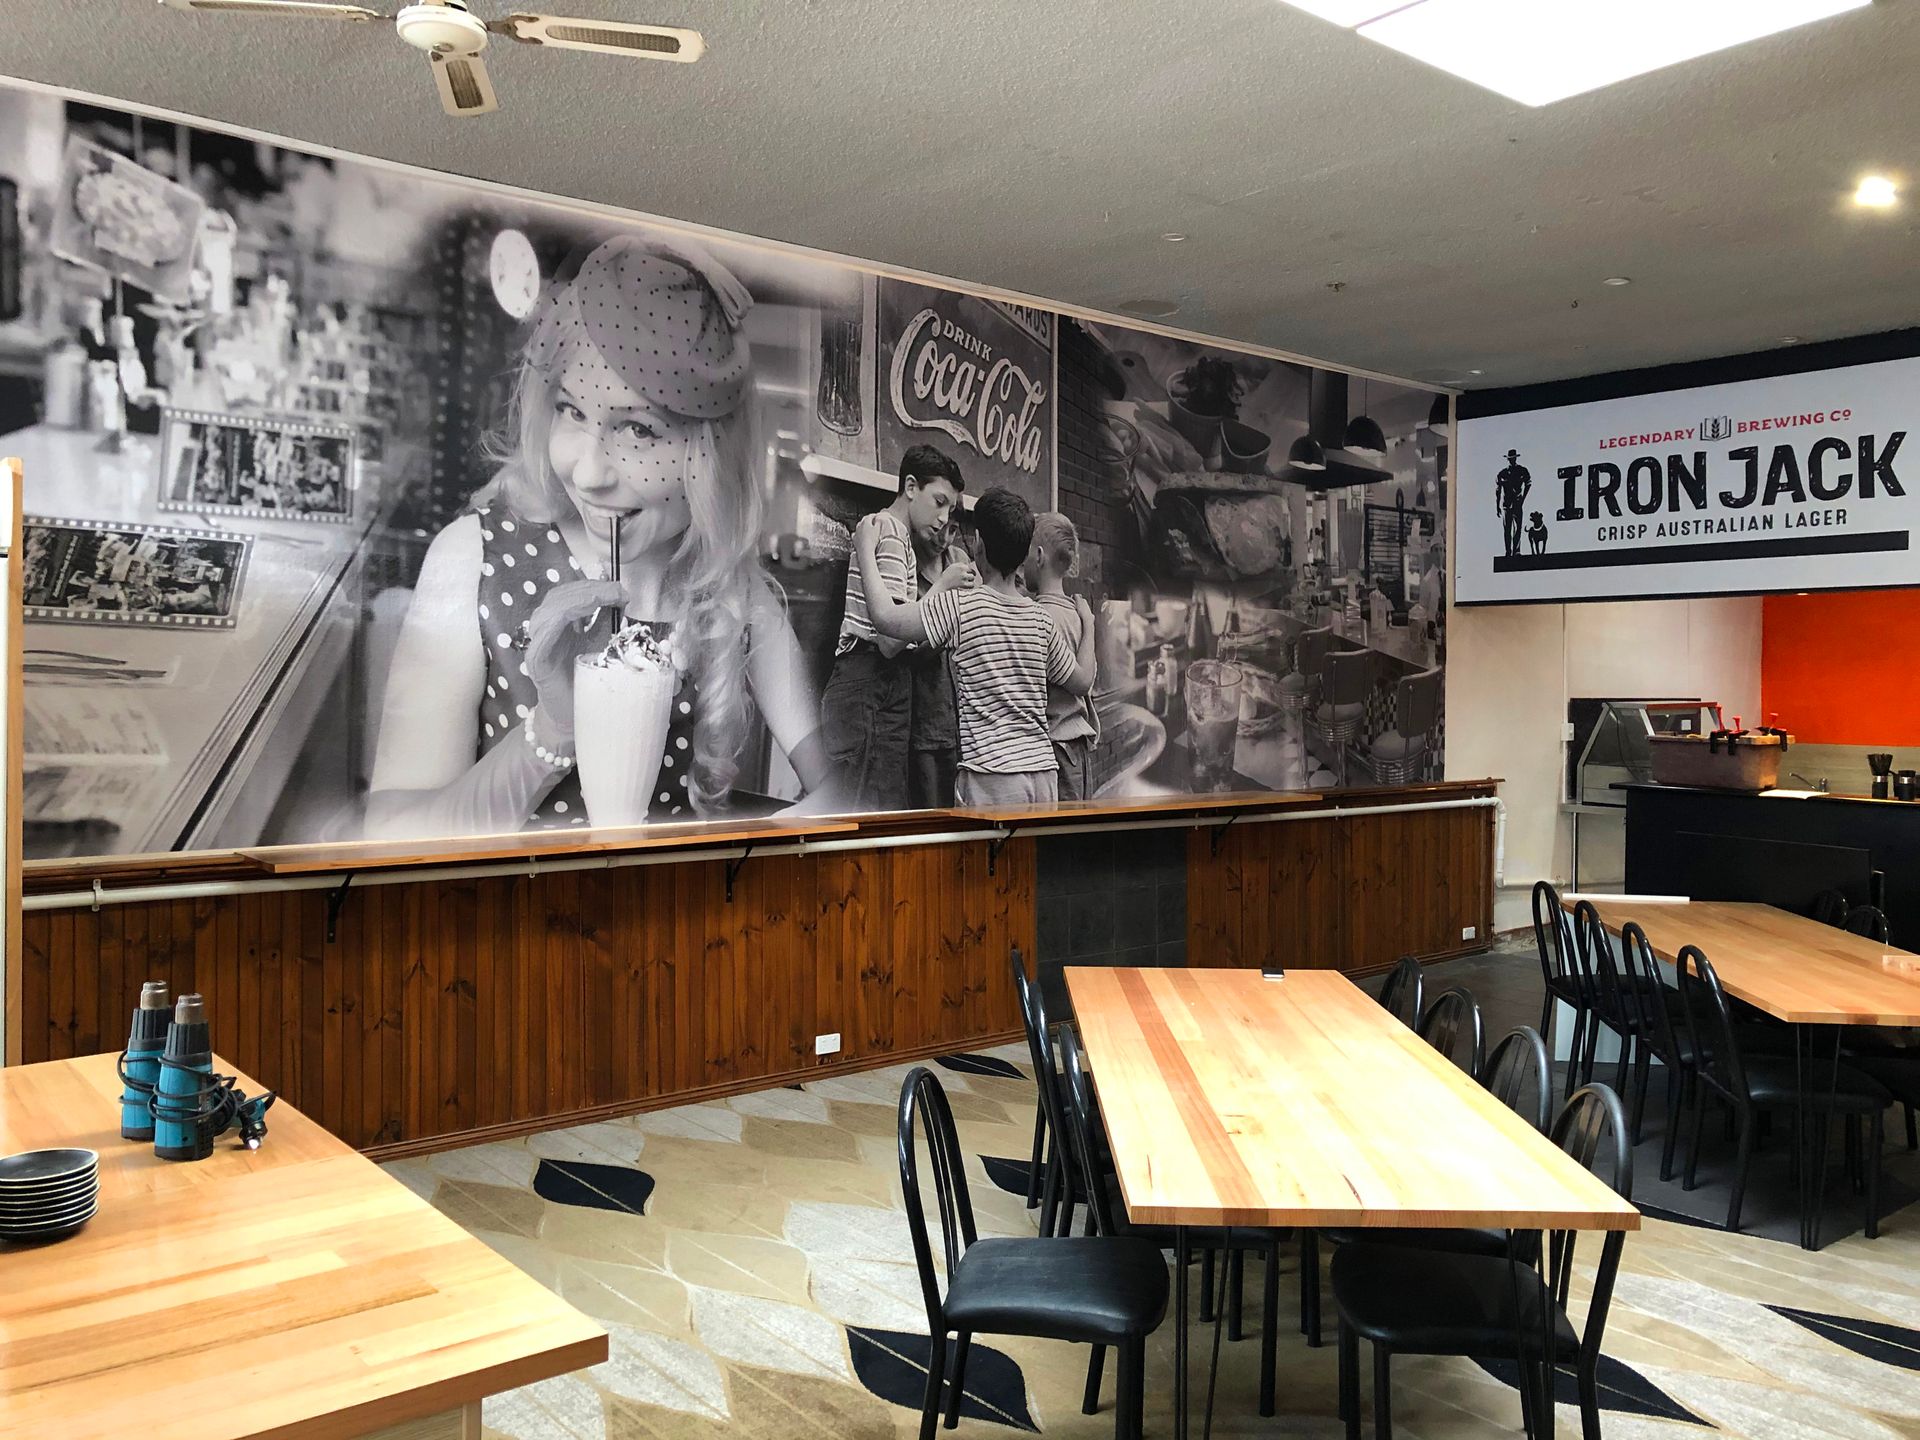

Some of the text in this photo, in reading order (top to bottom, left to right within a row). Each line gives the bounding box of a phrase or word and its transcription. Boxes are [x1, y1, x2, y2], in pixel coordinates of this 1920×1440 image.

[943, 319, 992, 361] DRINK
[1600, 428, 1695, 449] LEGENDARY
[1737, 412, 1825, 433] BREWING
[1556, 431, 1907, 521] IRON JACK
[1597, 508, 1848, 542] CRISP AUSTRALIAN LAGER
